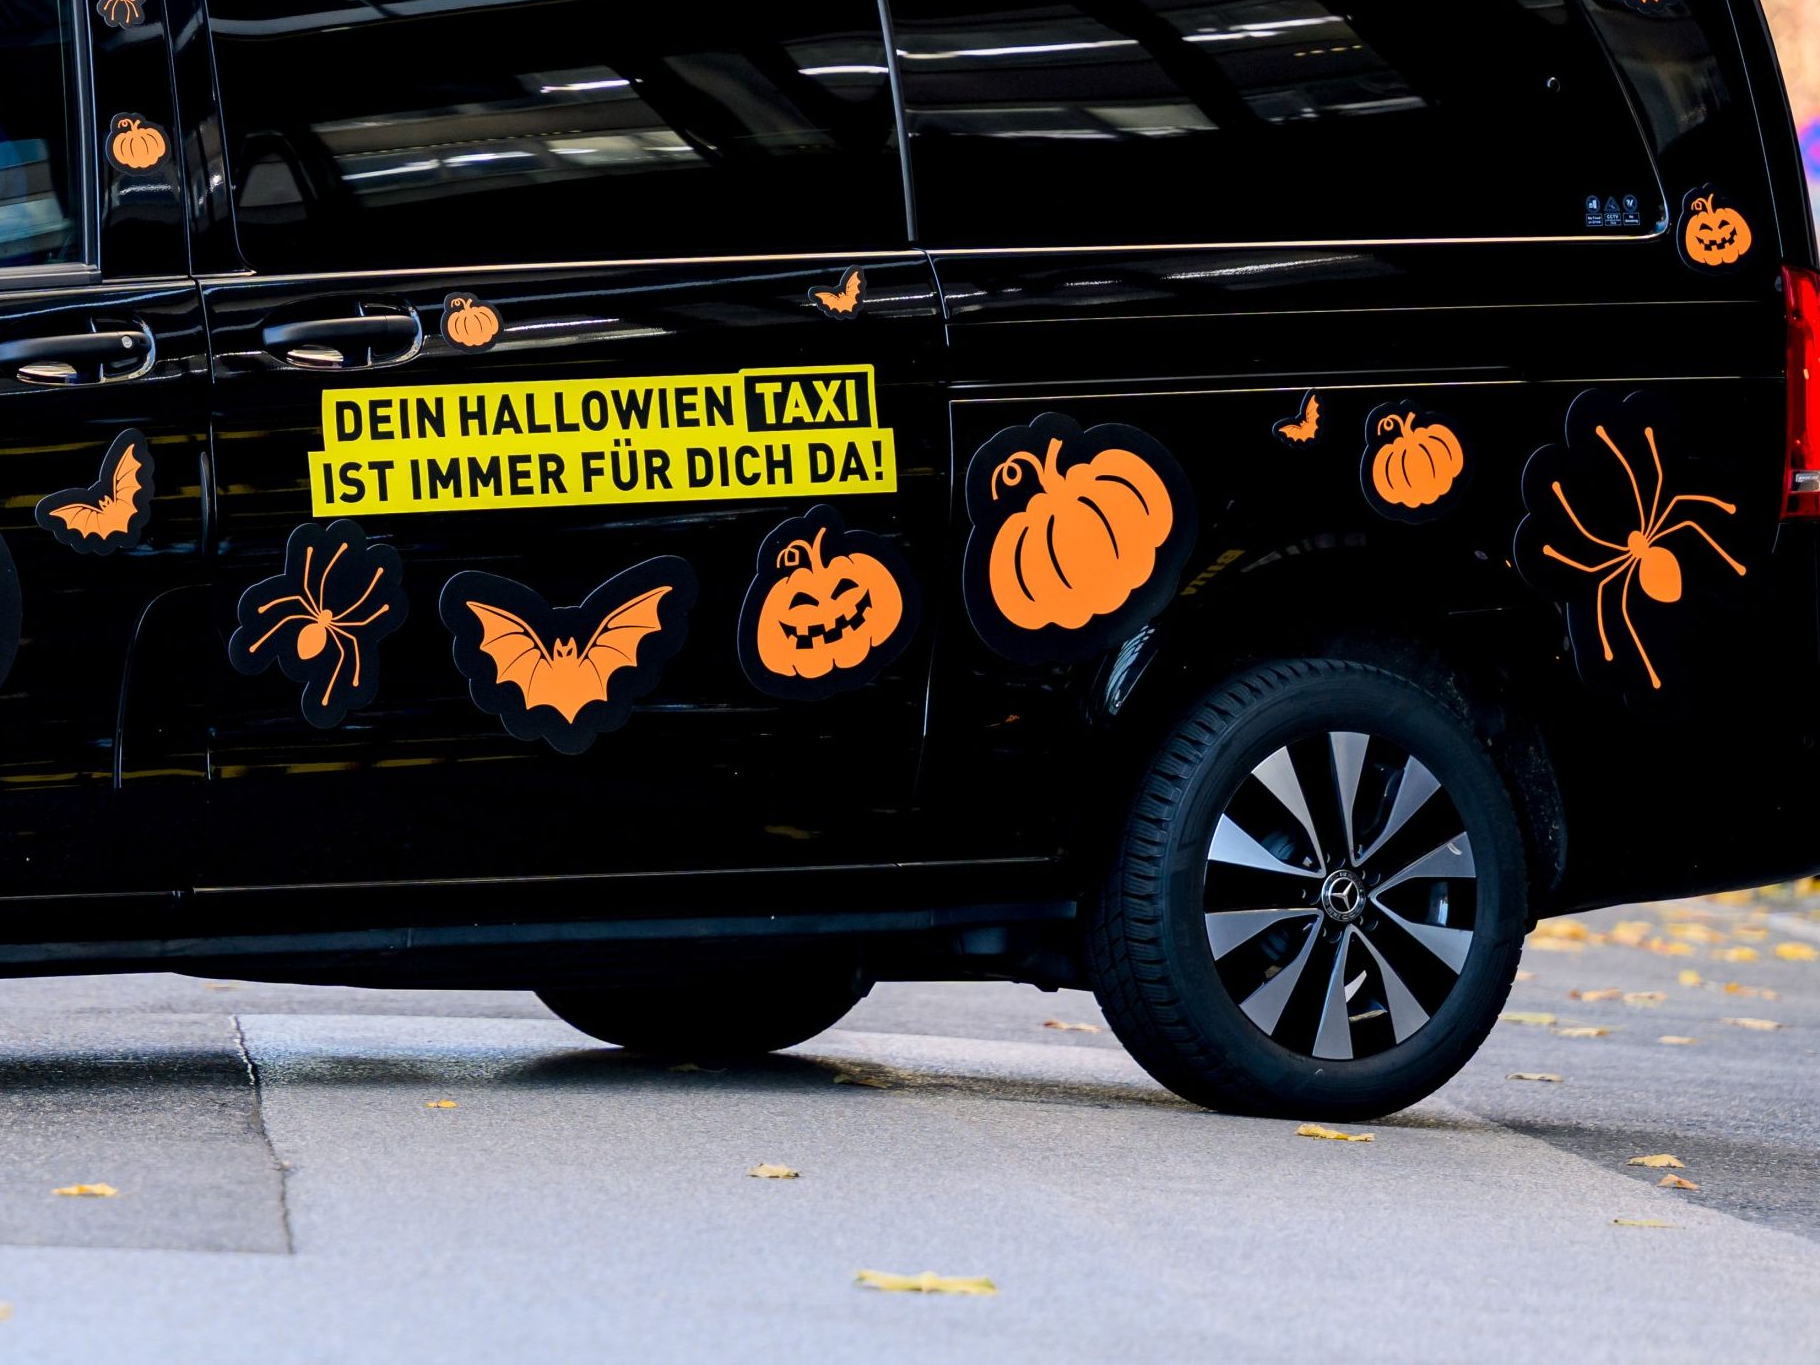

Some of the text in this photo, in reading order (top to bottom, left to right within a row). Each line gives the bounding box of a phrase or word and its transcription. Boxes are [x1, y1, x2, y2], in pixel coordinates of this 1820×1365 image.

[336, 379, 860, 442] DEIN HALLOWIEN TAXI
[323, 438, 885, 504] IST IMMER FÜR DICH DA!
